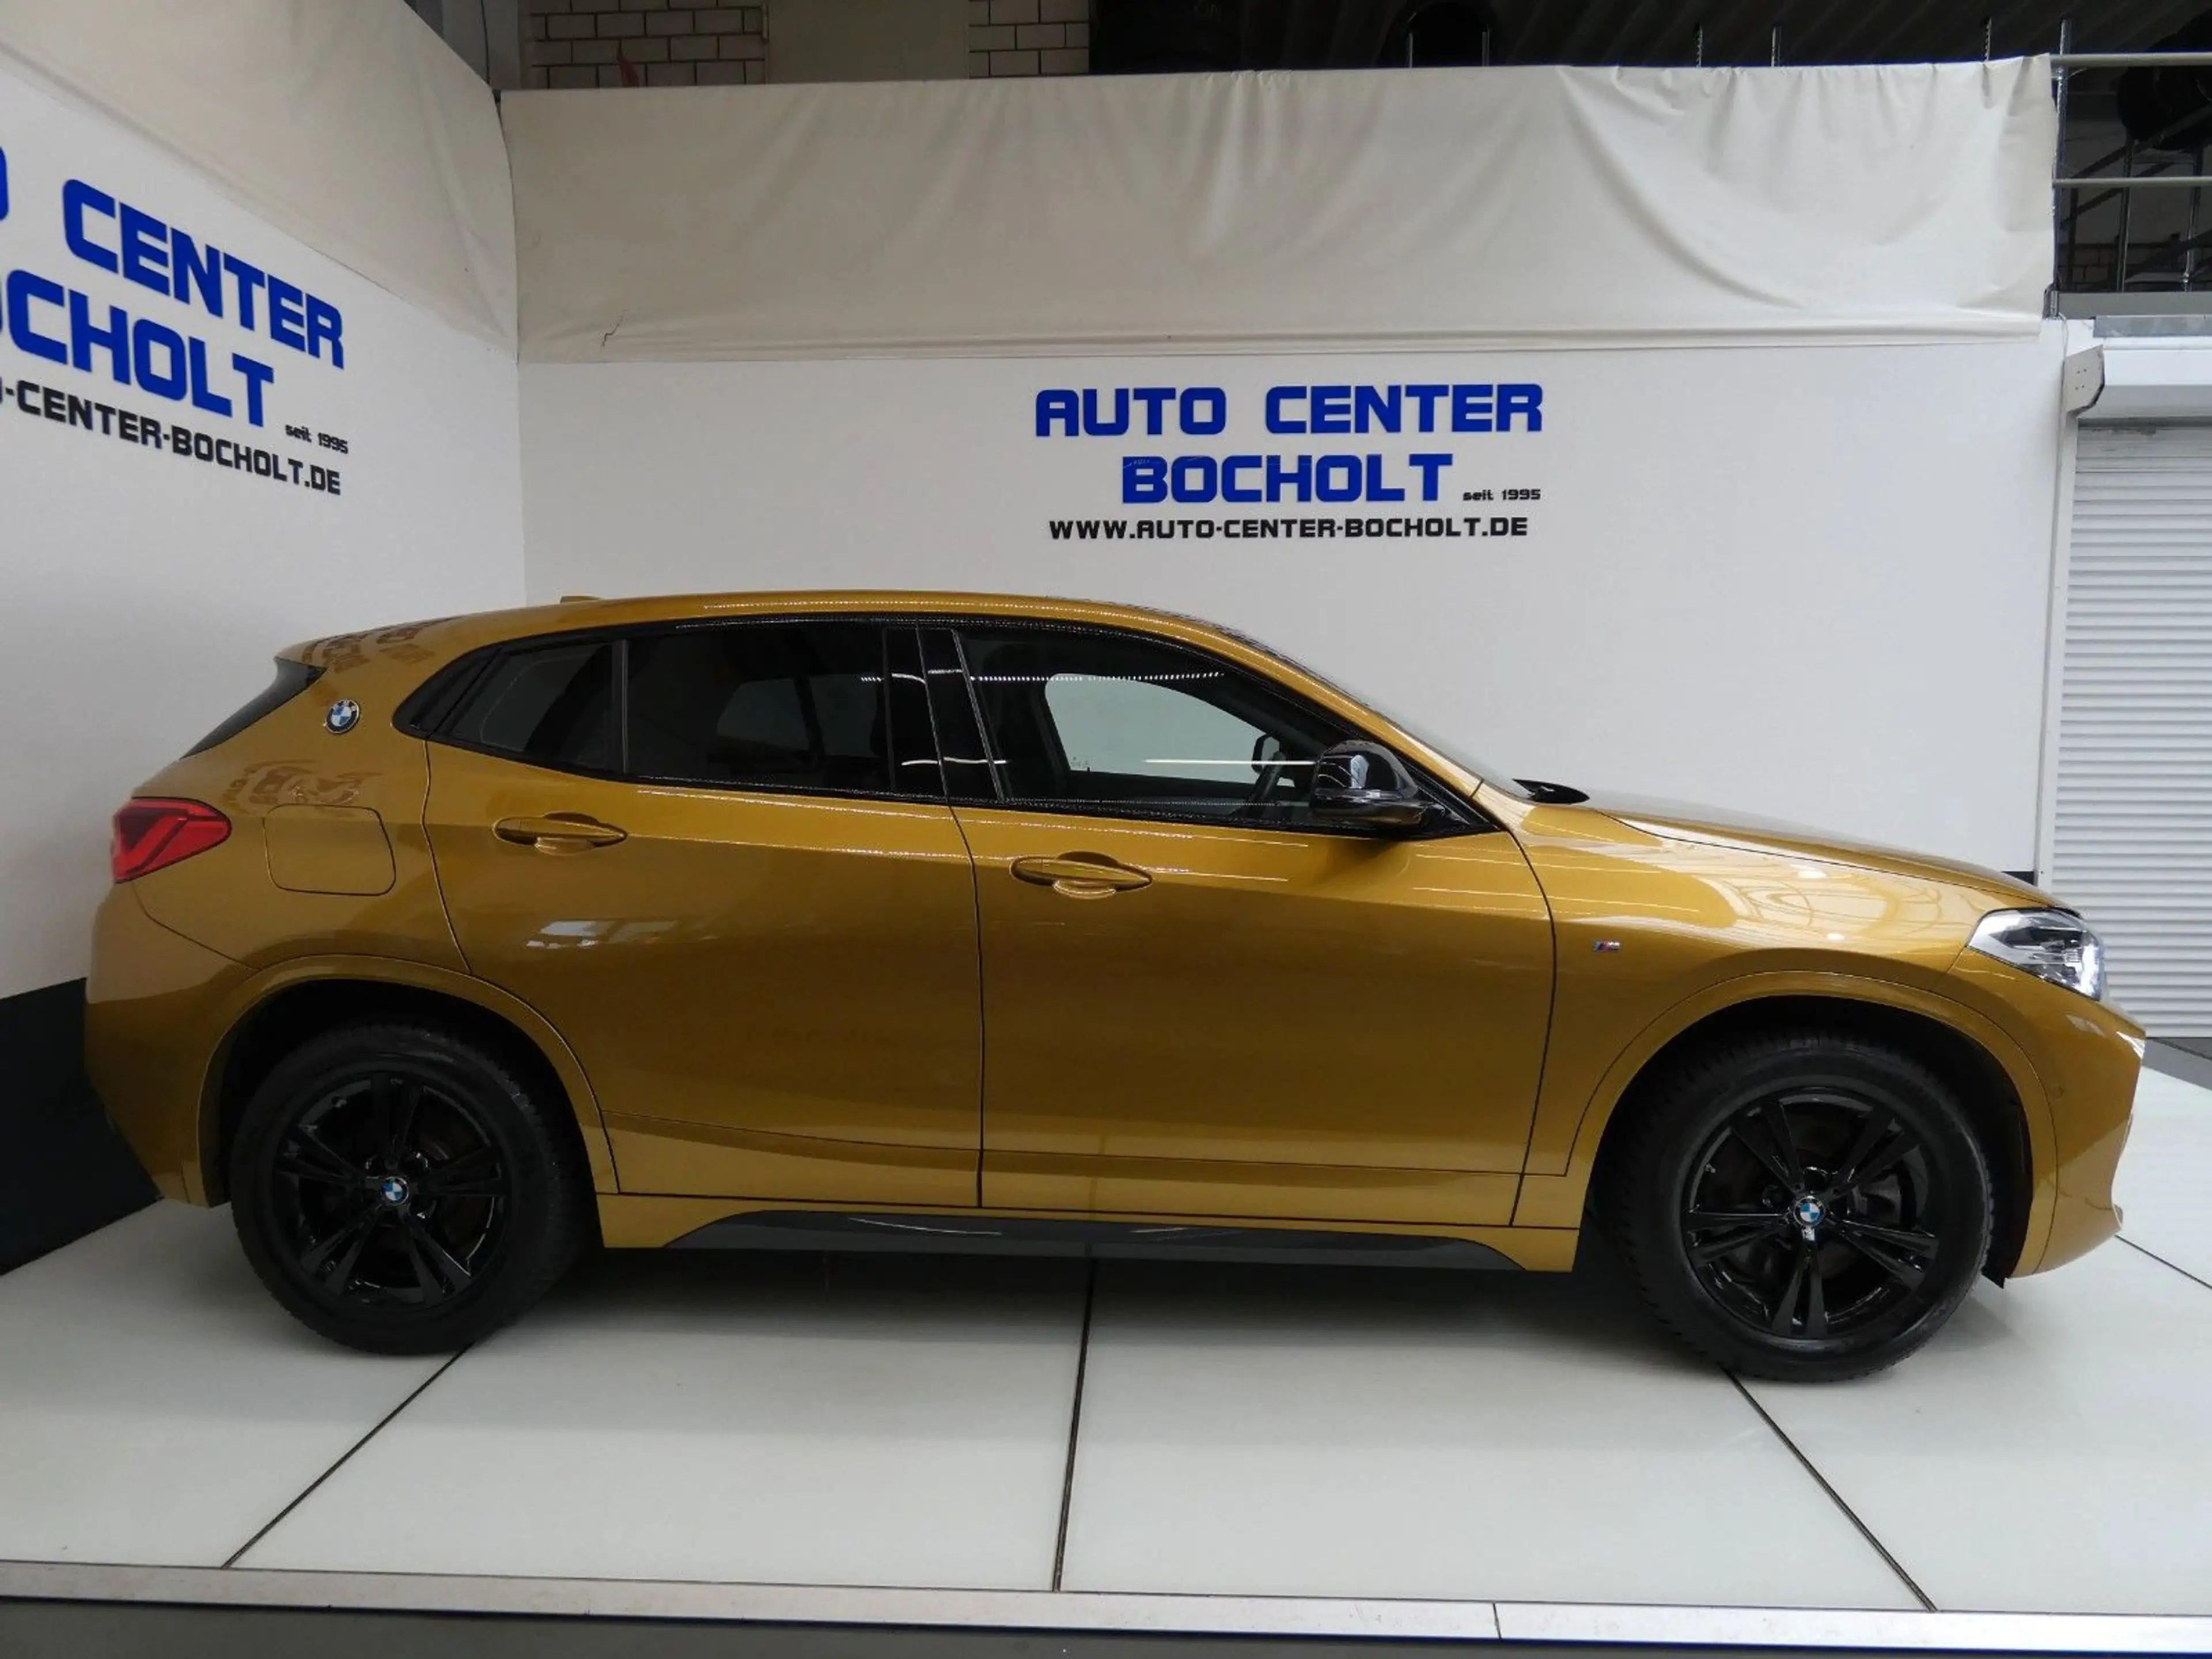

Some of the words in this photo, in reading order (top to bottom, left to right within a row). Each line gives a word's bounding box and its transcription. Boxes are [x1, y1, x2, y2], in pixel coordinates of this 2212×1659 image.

[62, 179, 344, 370] CENTER
[0, 269, 274, 428] CHOLT
[0, 377, 341, 496] -CENTER-BOCHOLT.DE
[1035, 387, 1227, 438] AUTO
[1264, 383, 1543, 435] CENTER
[317, 431, 349, 454] 1995
[1122, 453, 1453, 505] BOCHOLT
[1462, 488, 1494, 501] seit
[1501, 488, 1541, 501] 1995
[1048, 516, 1528, 540] WWW.AUTO-CENTER-BOCHOLT.DE
